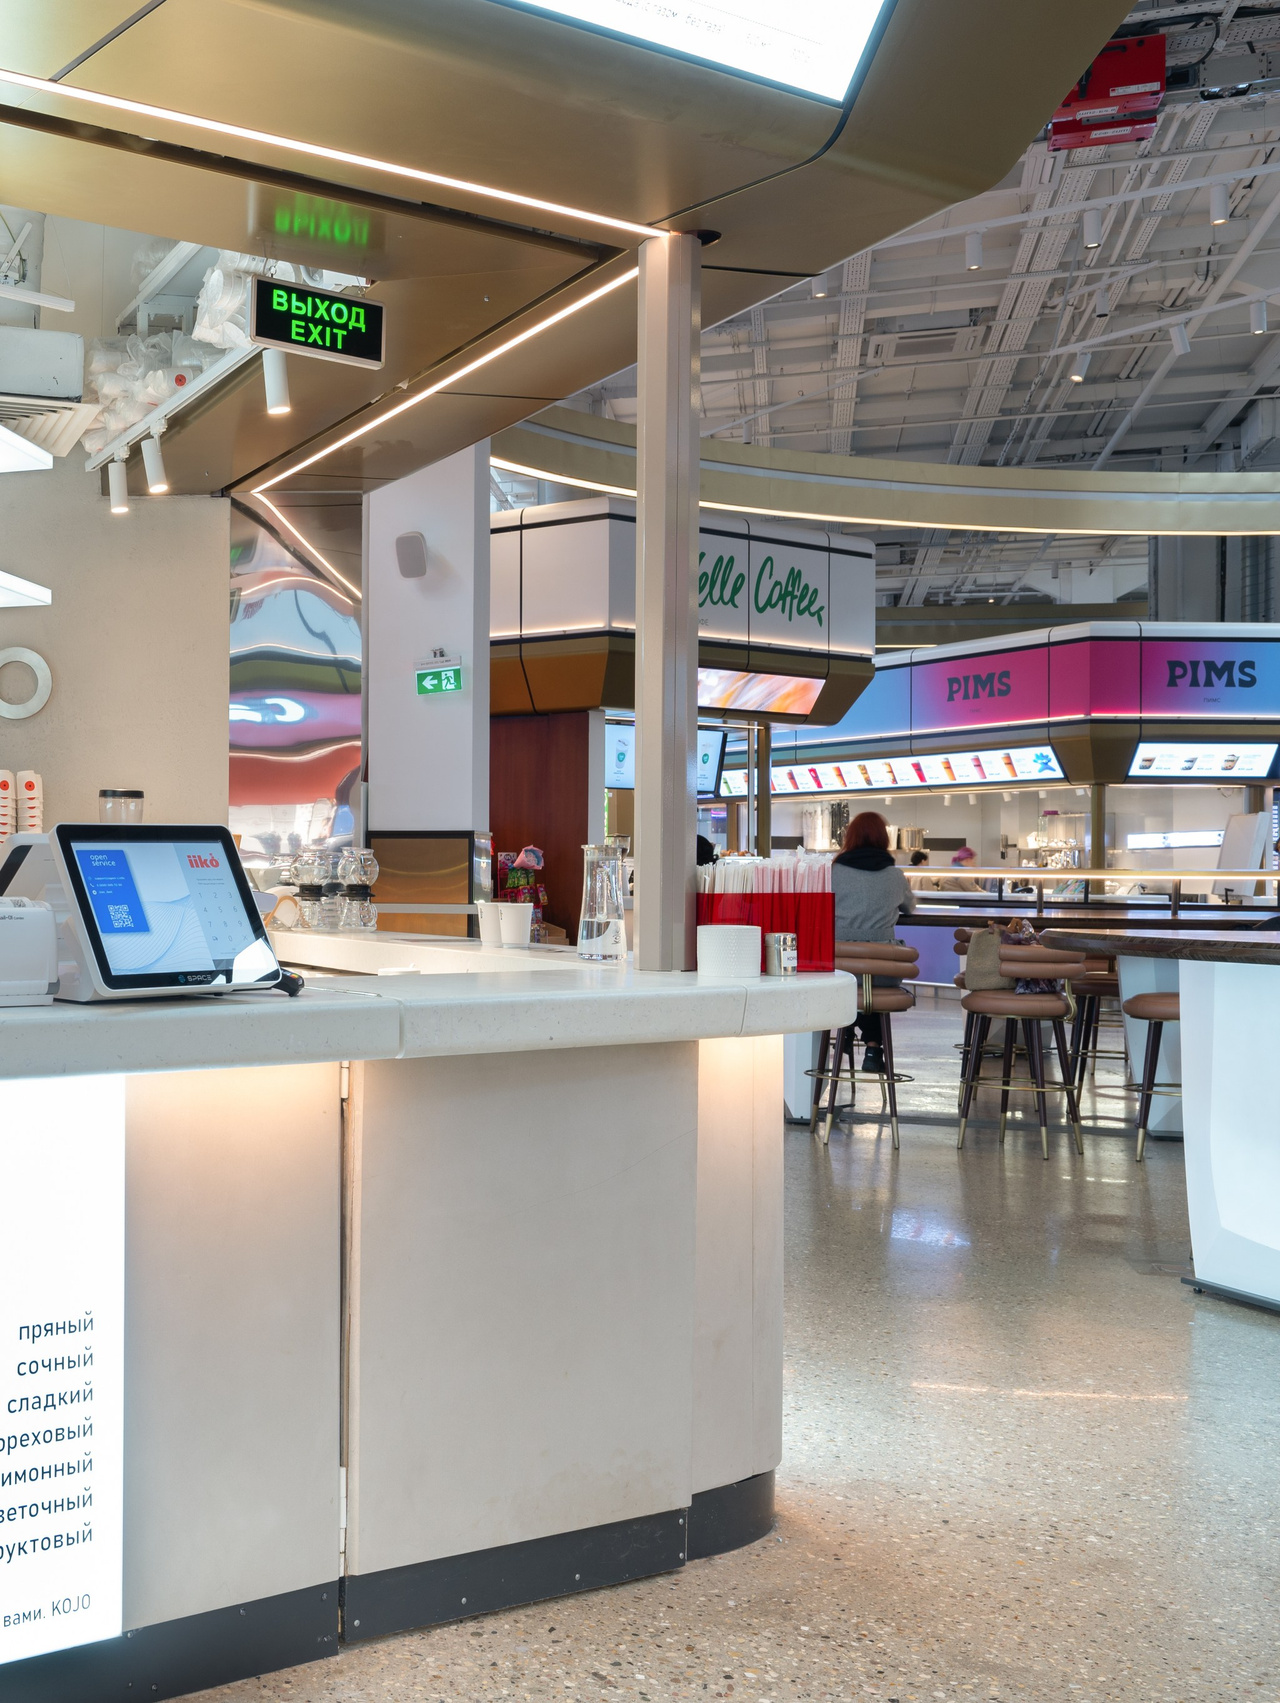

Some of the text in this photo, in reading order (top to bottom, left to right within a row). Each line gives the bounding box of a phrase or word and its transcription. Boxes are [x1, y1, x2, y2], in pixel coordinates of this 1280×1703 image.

[272, 289, 366, 333] ВЫХОД
[291, 320, 347, 349] EXIT
[699, 552, 746, 608] elle
[947, 670, 1012, 702] PIMS
[1166, 660, 1257, 688] PIMS
[187, 853, 220, 869] iiko
[19, 1311, 94, 1344] пряный
[17, 1346, 94, 1377] сочный
[7, 1381, 93, 1414] сладкий
[4, 1609, 45, 1627] вами.
